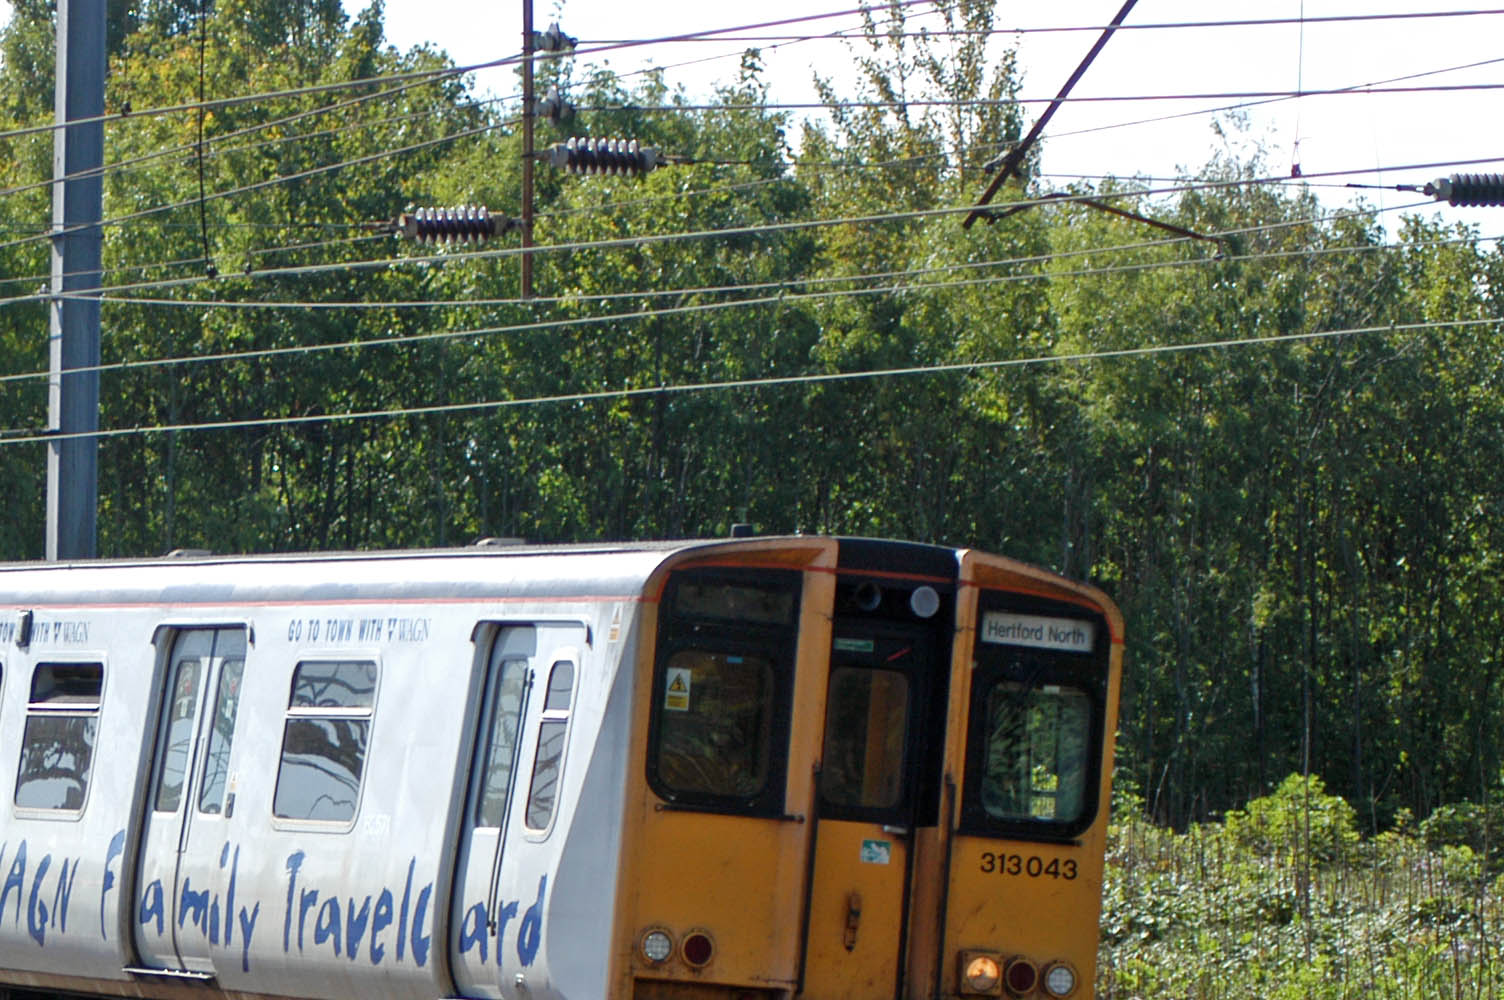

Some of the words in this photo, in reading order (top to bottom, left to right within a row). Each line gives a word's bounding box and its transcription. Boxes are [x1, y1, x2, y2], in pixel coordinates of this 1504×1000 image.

[288, 619, 302, 642] GO
[307, 619, 320, 642] TO
[325, 619, 353, 642] TOWN
[359, 619, 383, 641] WITH
[987, 621, 1043, 641] Hertford
[1047, 625, 1085, 645] North
[980, 852, 1078, 881] 313043
